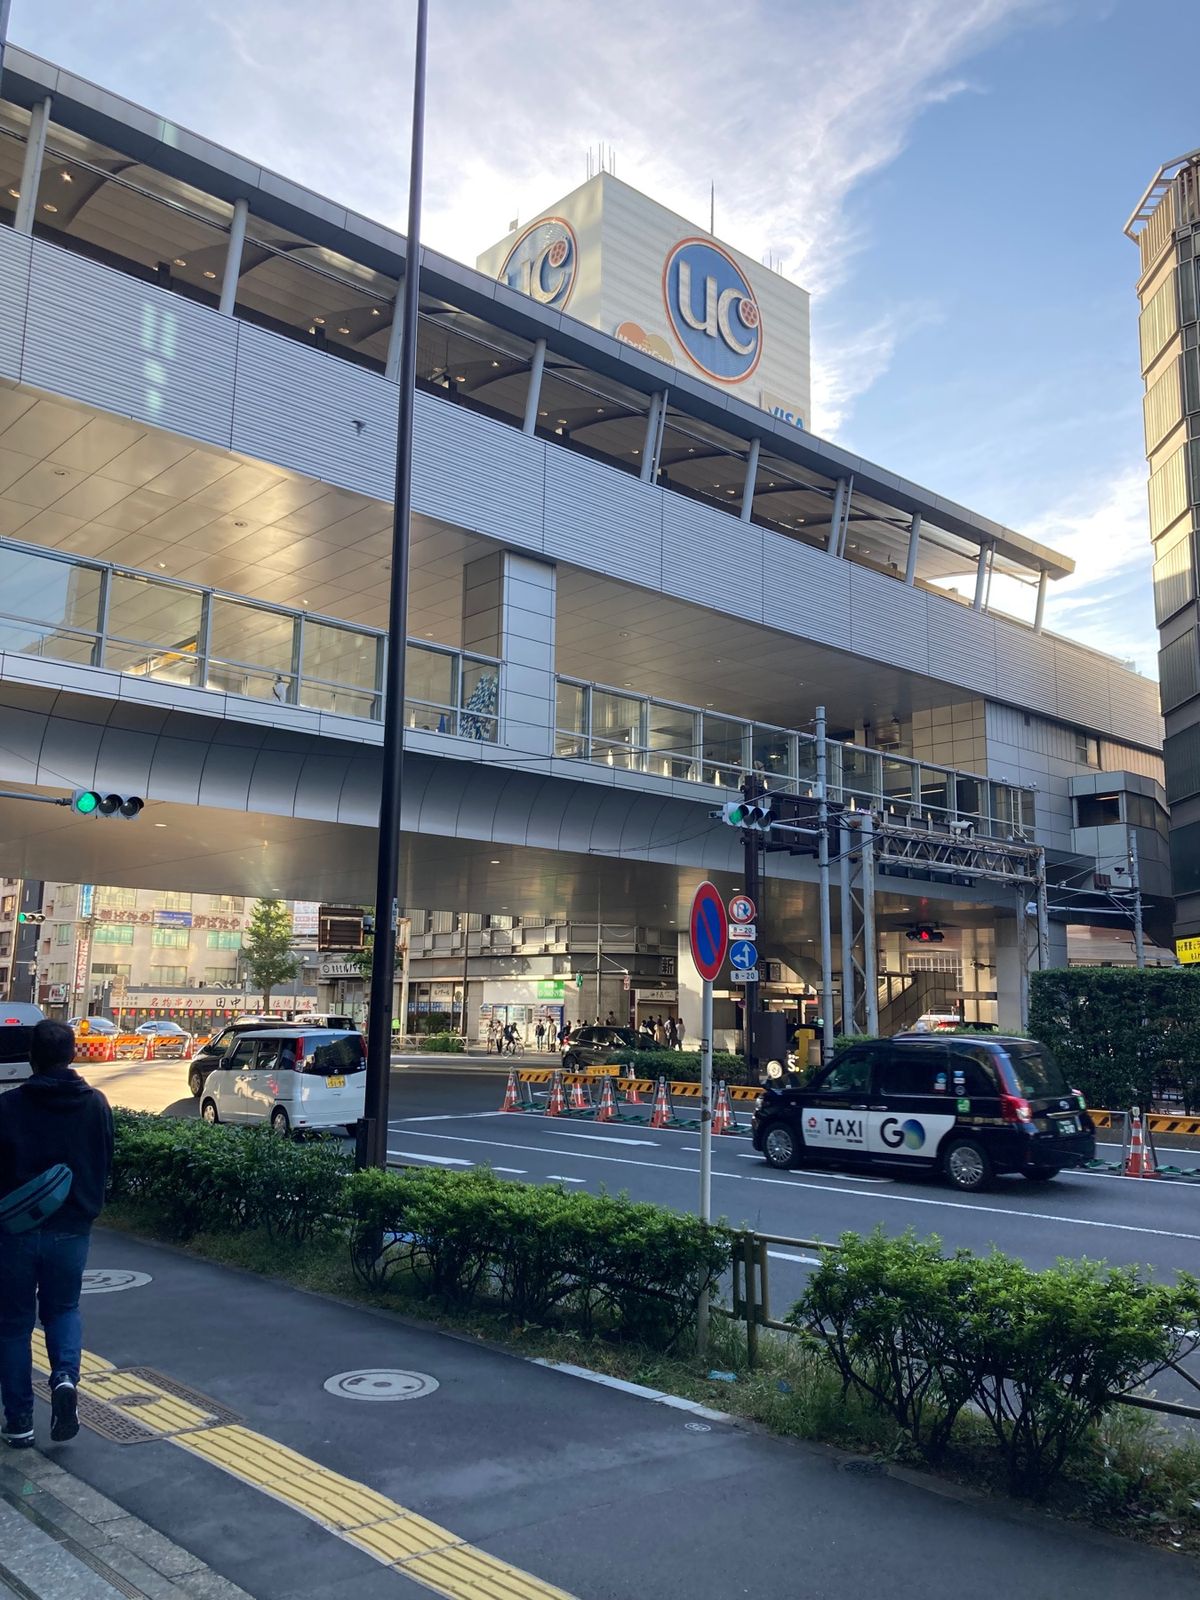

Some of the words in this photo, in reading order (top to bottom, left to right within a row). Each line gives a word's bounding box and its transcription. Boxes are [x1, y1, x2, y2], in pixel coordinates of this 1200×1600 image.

[735, 972, 755, 980] 8-20
[824, 1117, 863, 1138] TAXI
[880, 1117, 926, 1150] GO
